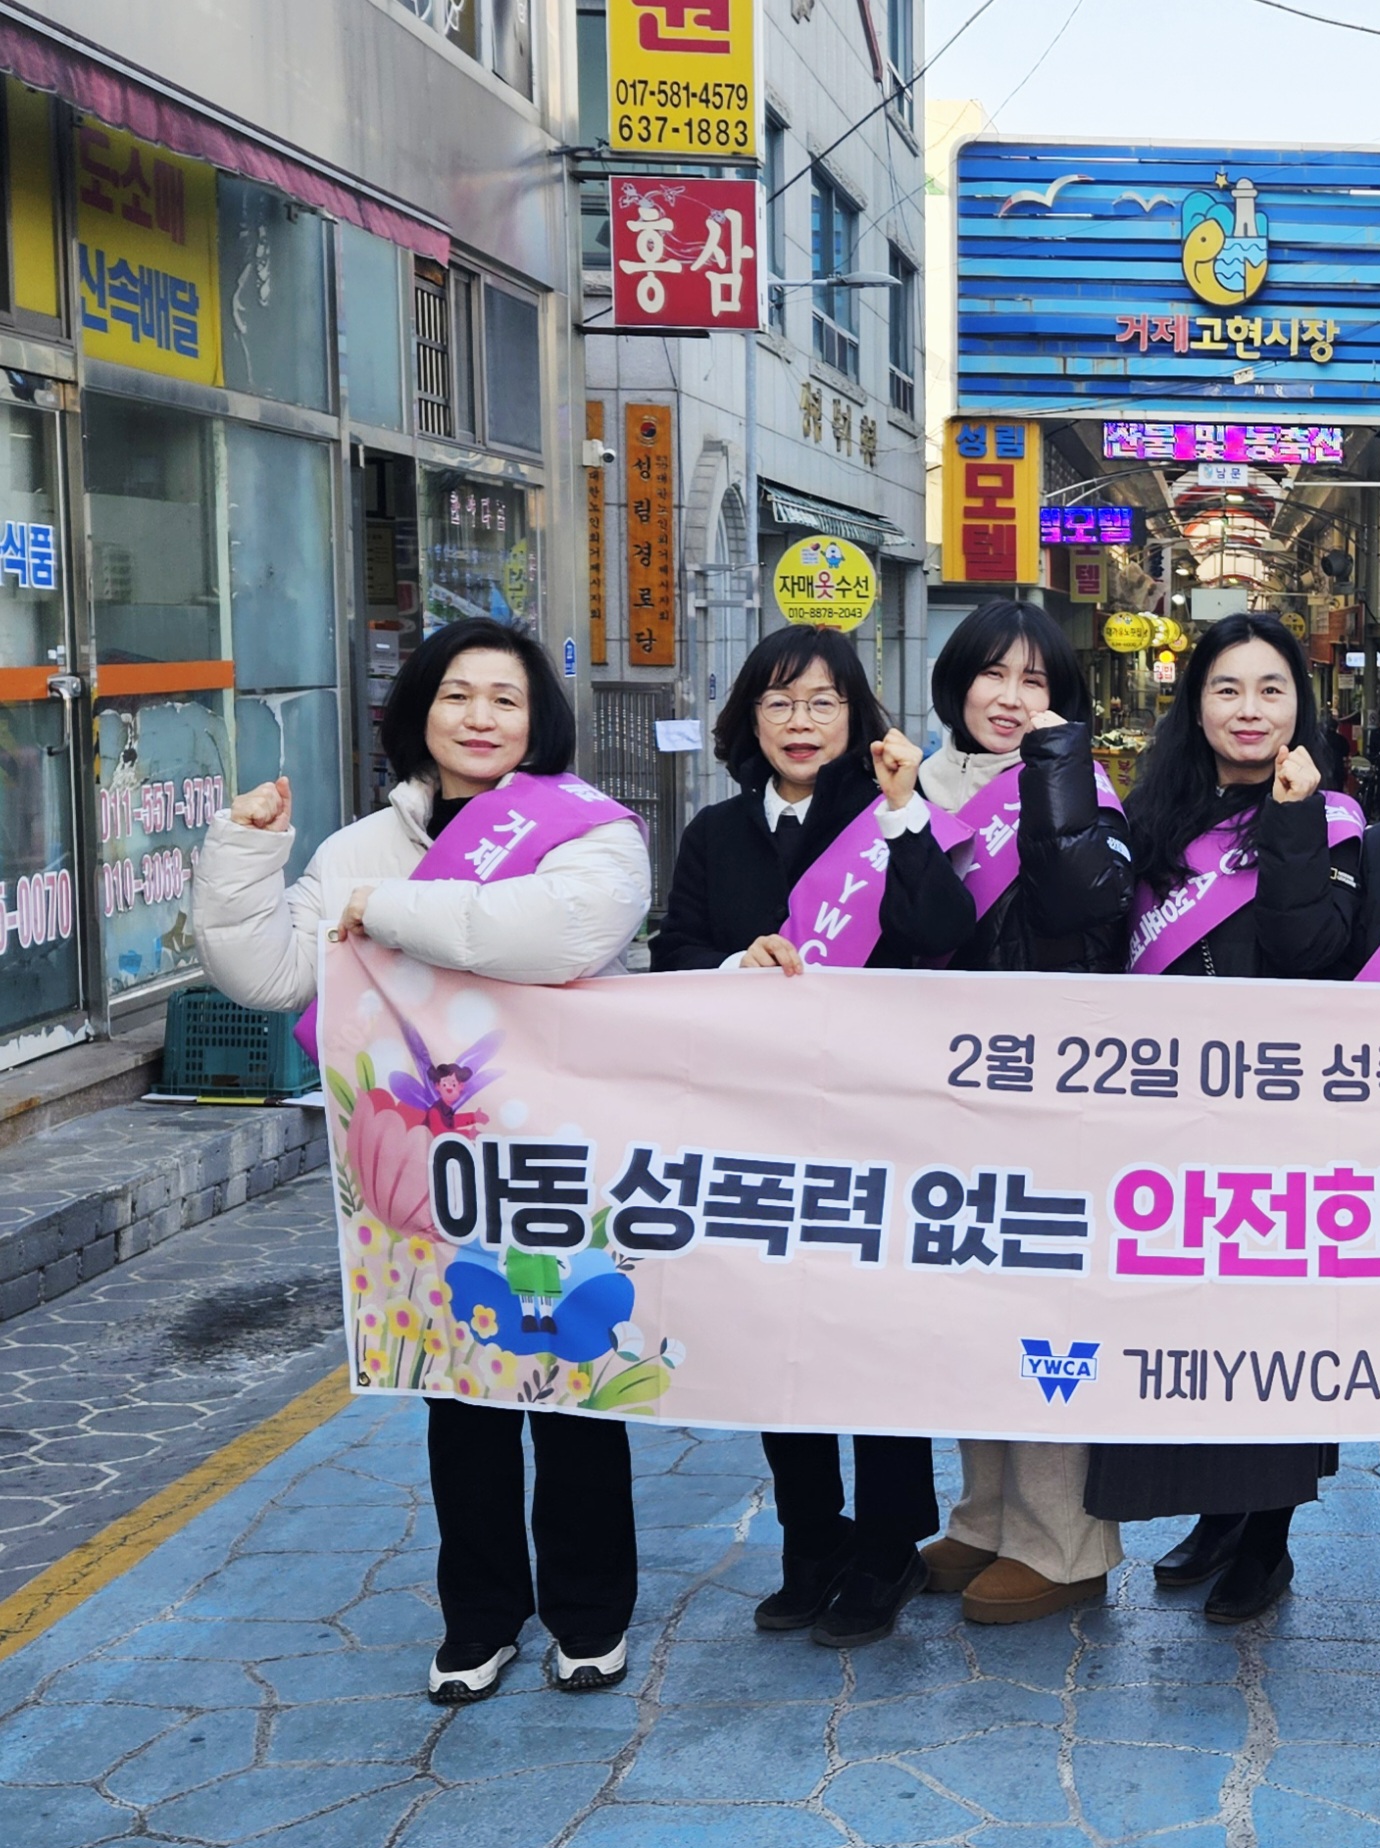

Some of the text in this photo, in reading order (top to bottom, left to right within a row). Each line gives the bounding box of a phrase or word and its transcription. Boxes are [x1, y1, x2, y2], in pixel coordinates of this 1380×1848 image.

[616, 79, 748, 110] 017-581-4579
[618, 115, 748, 147] 637-1883
[79, 126, 186, 246] 도소매
[618, 207, 754, 317] 홍삼
[78, 243, 200, 359] 신속배달
[1115, 314, 1341, 363] 거제고현시장
[956, 423, 1025, 459] 성림
[1216, 467, 1241, 479] 남문
[0, 520, 56, 590] 식품
[633, 454, 657, 654] 성림경로당
[962, 463, 1017, 582] 모텔
[779, 571, 870, 599] 자매옷수선
[788, 608, 862, 619] 010-8878-2043
[100, 775, 224, 844] 011-557-3737
[464, 809, 537, 882] 거제
[948, 1033, 1036, 1093] 2월
[1056, 1037, 1180, 1098] 22일
[1200, 1039, 1304, 1102] 아동
[433, 1139, 590, 1249] 아동
[609, 1148, 888, 1263] 성폭력
[910, 1170, 1088, 1270] 없는
[1028, 1358, 1091, 1377] YWCA
